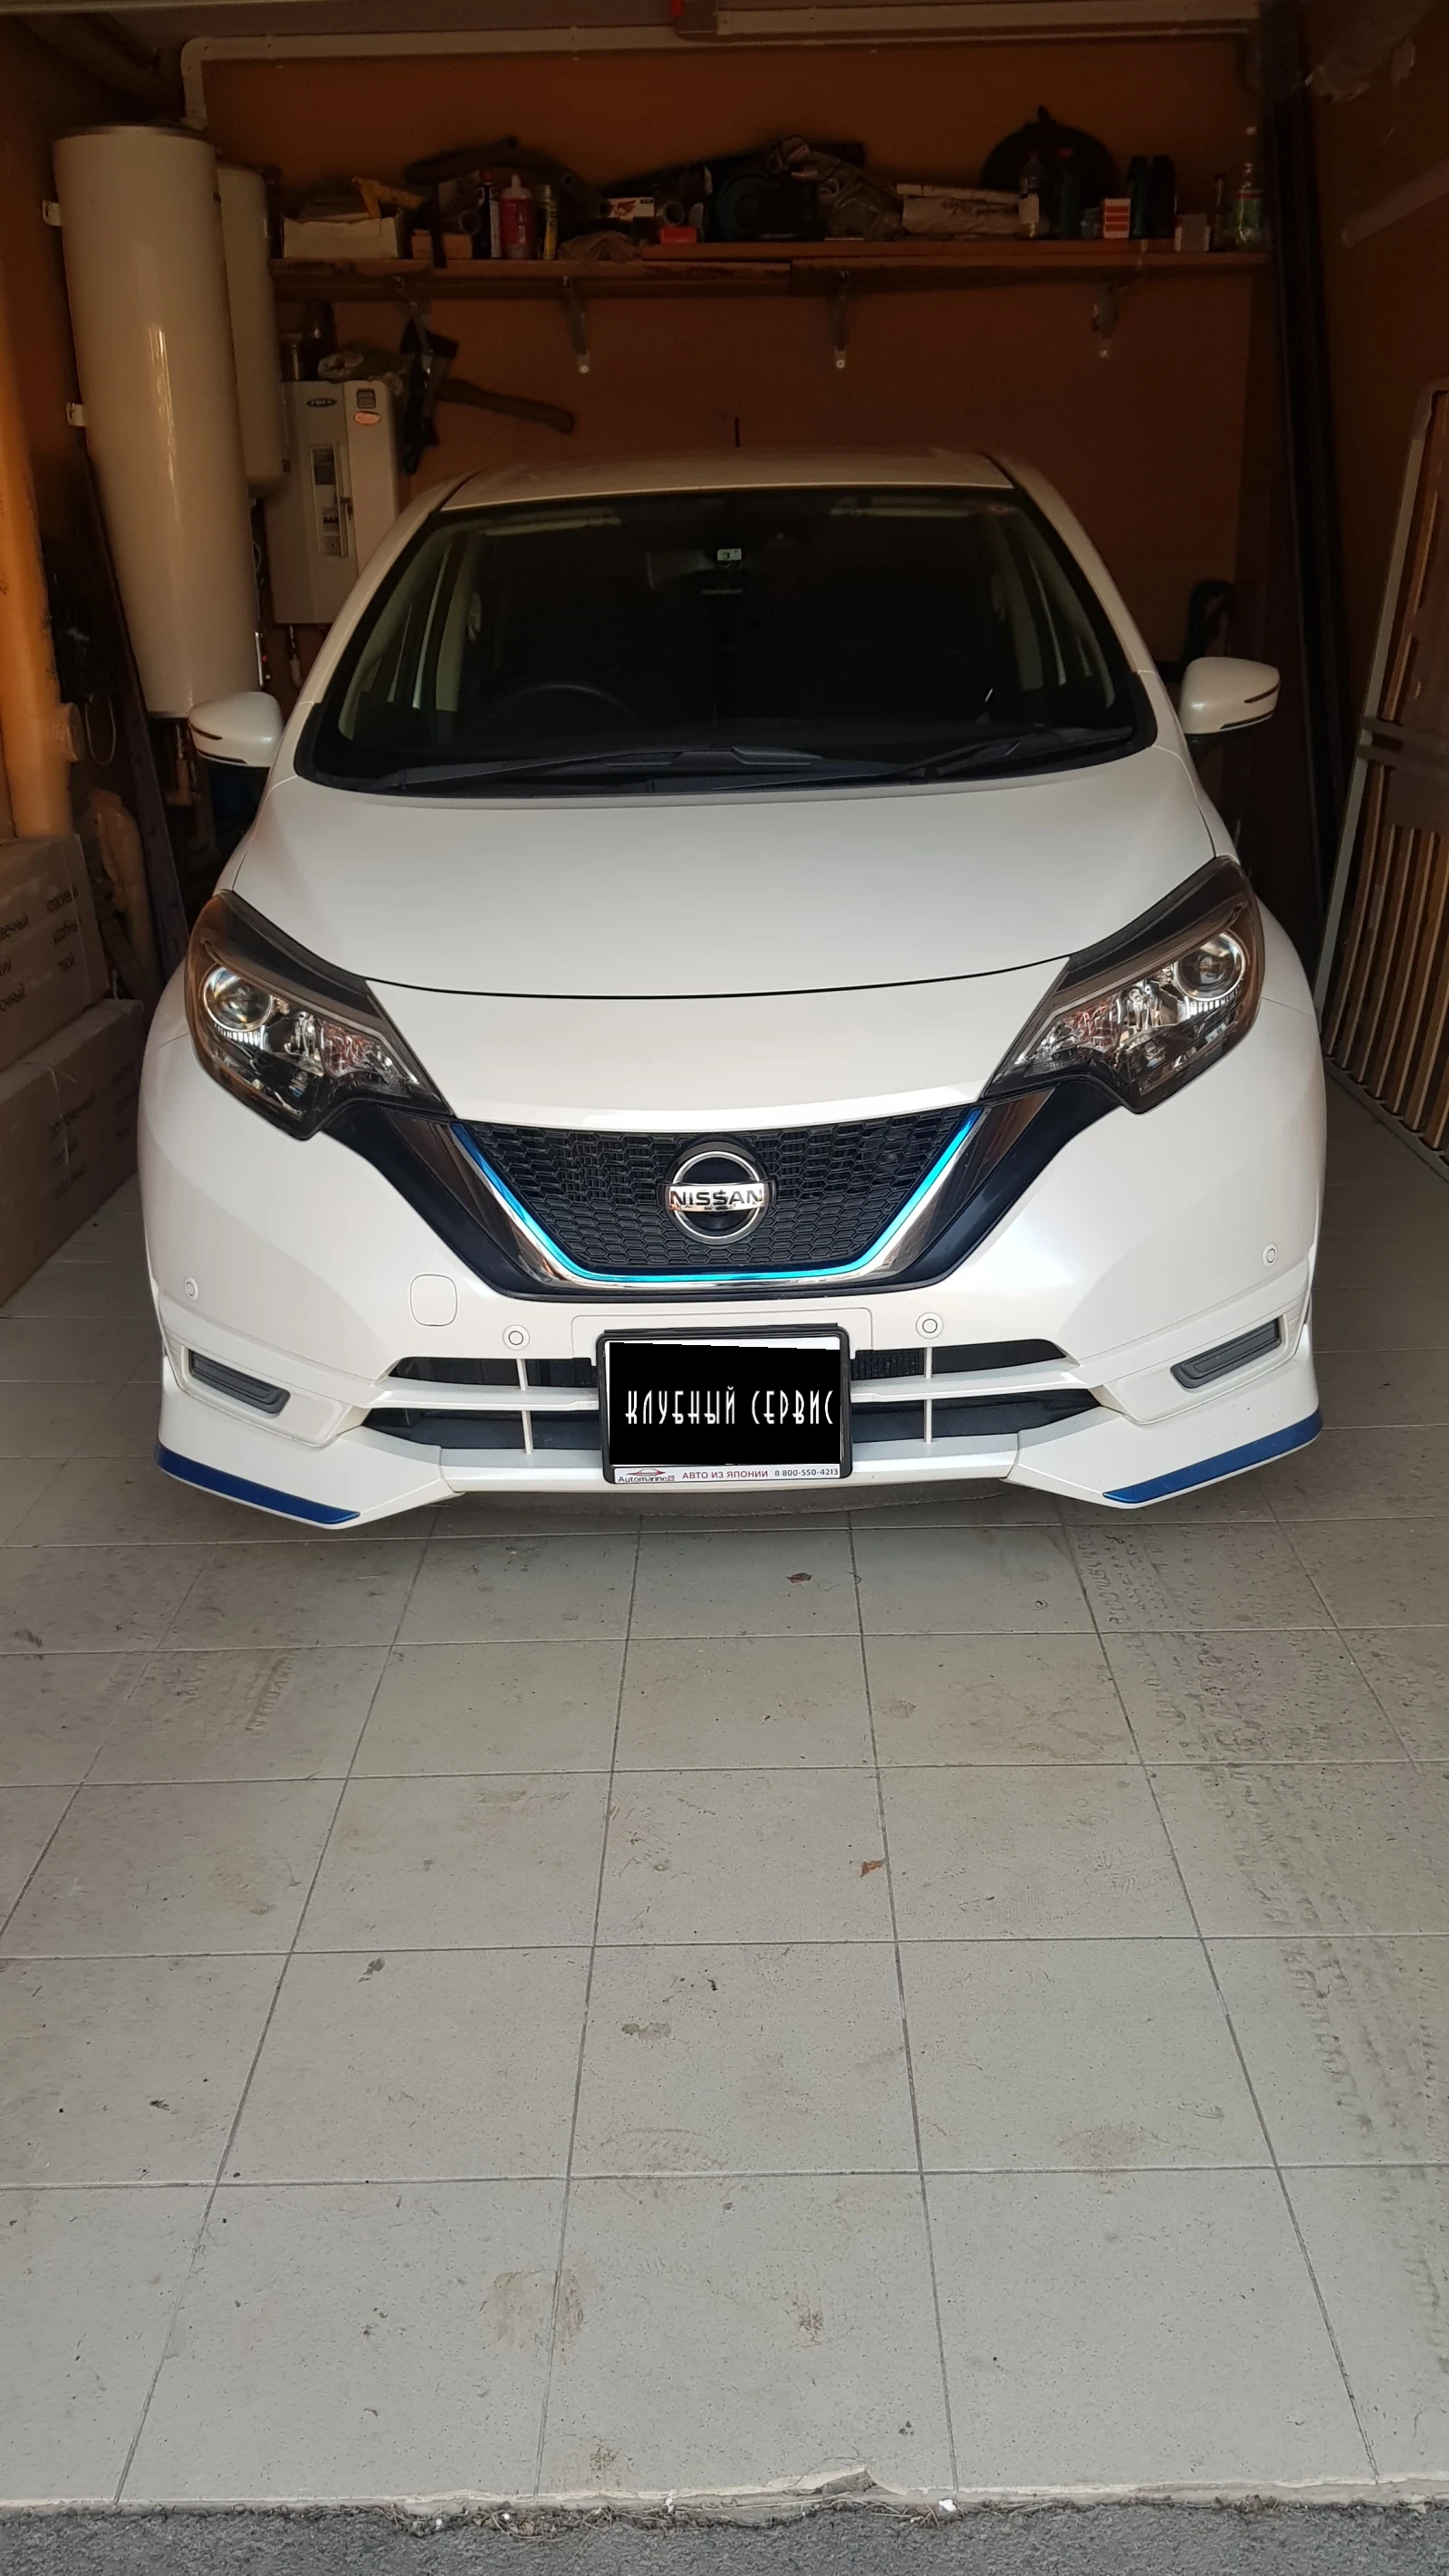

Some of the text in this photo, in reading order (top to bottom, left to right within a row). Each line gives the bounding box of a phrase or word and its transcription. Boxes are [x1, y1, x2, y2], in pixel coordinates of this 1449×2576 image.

[670, 1189, 763, 1206] NISSAN
[682, 1471, 708, 1479] АВТО
[726, 1470, 768, 1478] ЯПОНИИ
[782, 1468, 839, 1476] 800-550-4213
